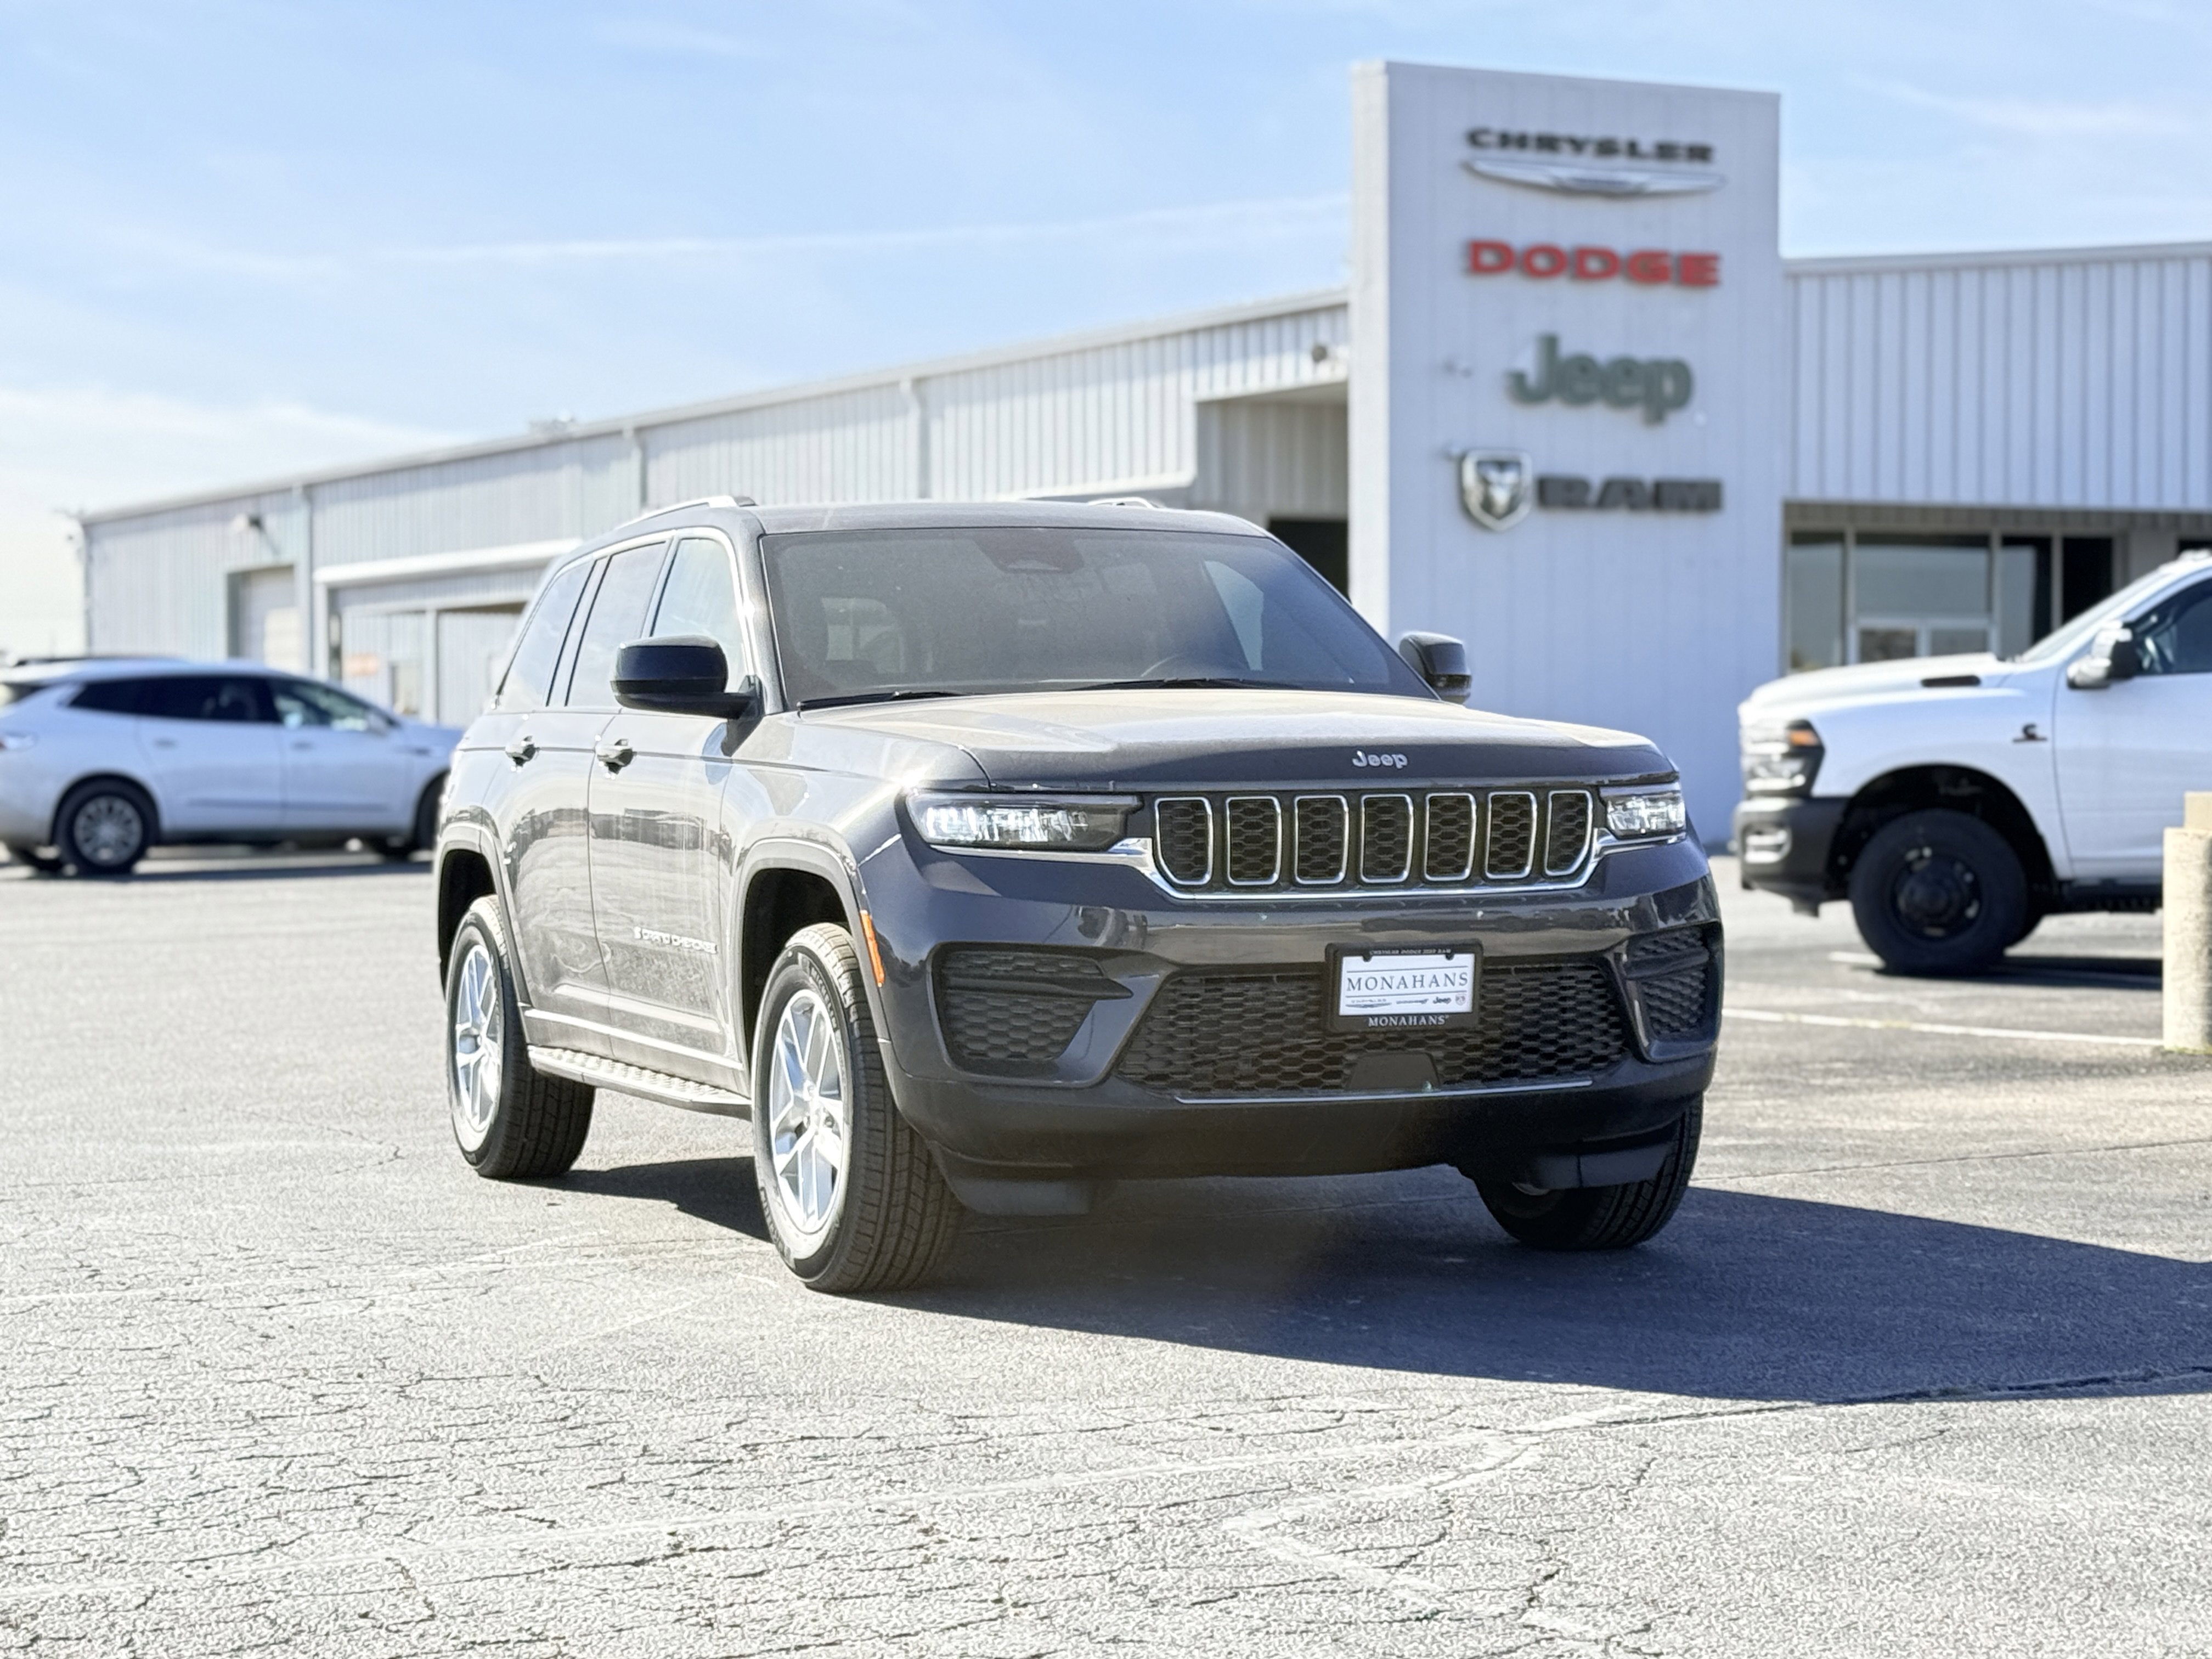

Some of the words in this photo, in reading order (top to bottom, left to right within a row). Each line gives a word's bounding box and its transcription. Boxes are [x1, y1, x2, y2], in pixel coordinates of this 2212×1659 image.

[1466, 129, 1714, 163] CHRYSLER
[1469, 239, 1720, 288] DODGE
[1505, 332, 1694, 427] Jeep
[1537, 476, 1723, 512] RAM
[1352, 750, 1408, 769] Jeep
[1347, 972, 1469, 992] MONAHANS
[1368, 1016, 1446, 1028] MONAHANS
